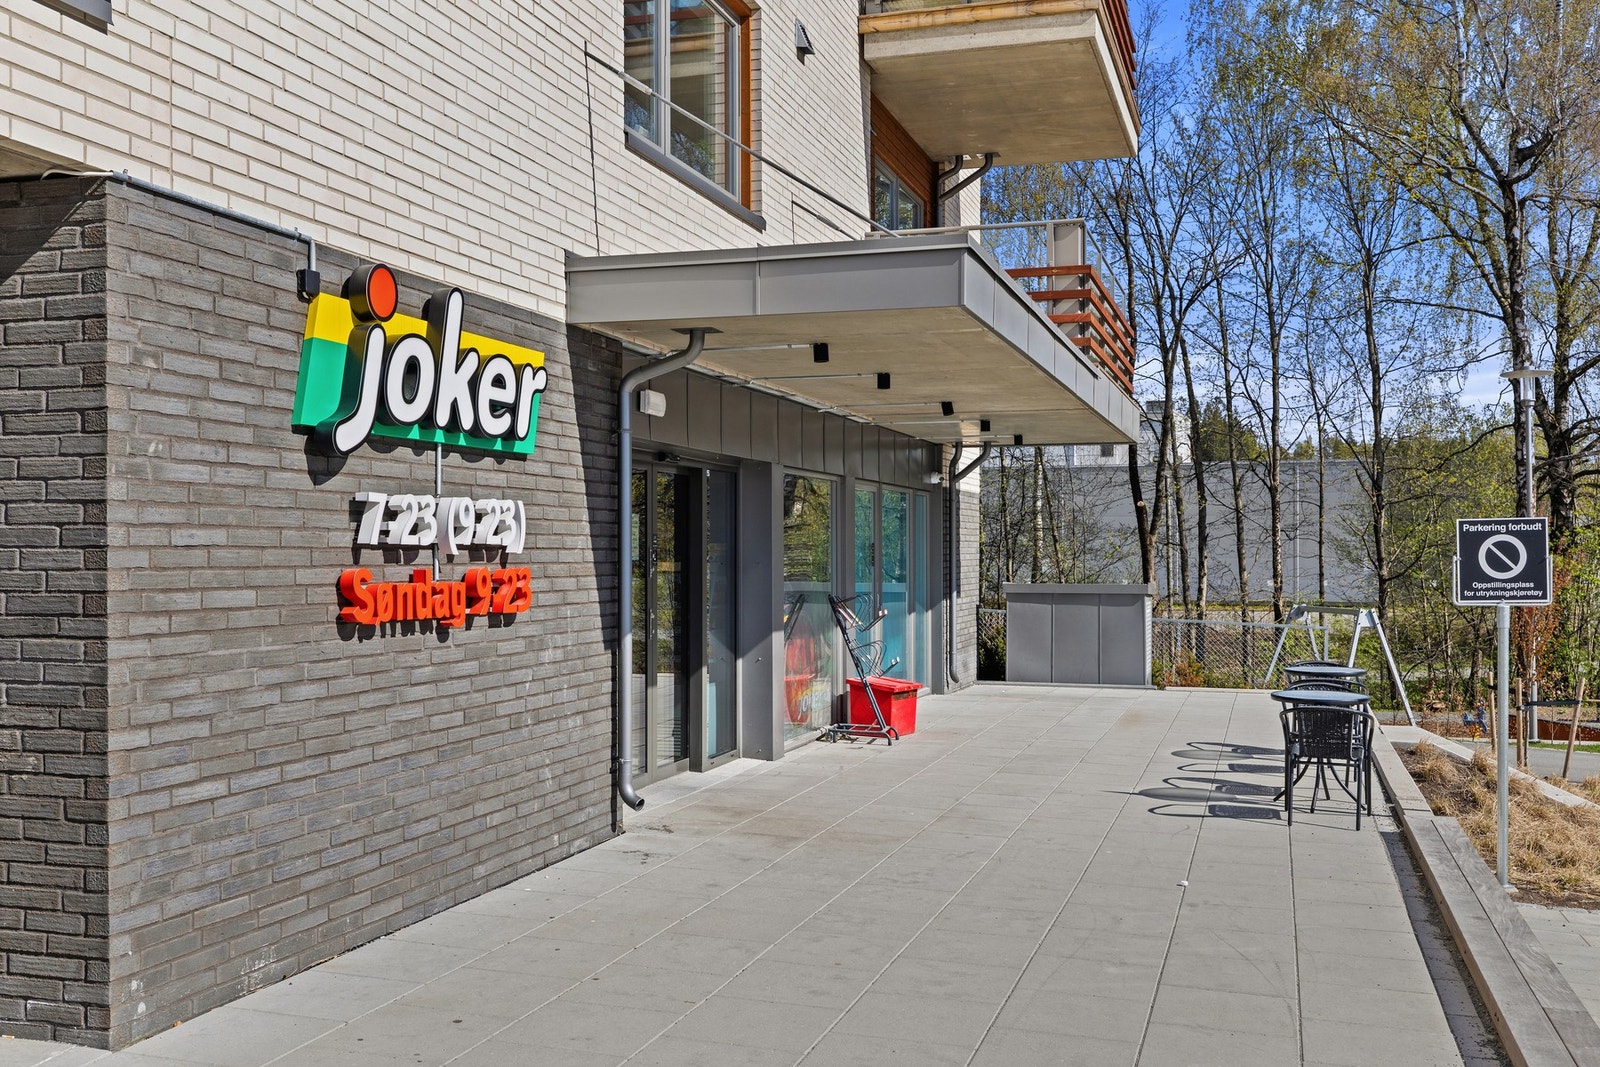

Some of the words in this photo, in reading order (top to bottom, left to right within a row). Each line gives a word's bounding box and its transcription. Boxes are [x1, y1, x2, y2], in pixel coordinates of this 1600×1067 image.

[334, 264, 547, 456] joker
[355, 492, 437, 546] 7-23
[446, 496, 526, 555] (9-23)
[1463, 524, 1506, 532] Parkering
[1508, 522, 1542, 531] forbudt
[342, 567, 466, 628] Søndag
[466, 567, 532, 615] 9-23
[1472, 581, 1534, 589] Oppstillingsplass
[1476, 589, 1543, 597] utrykningskjøretøy
